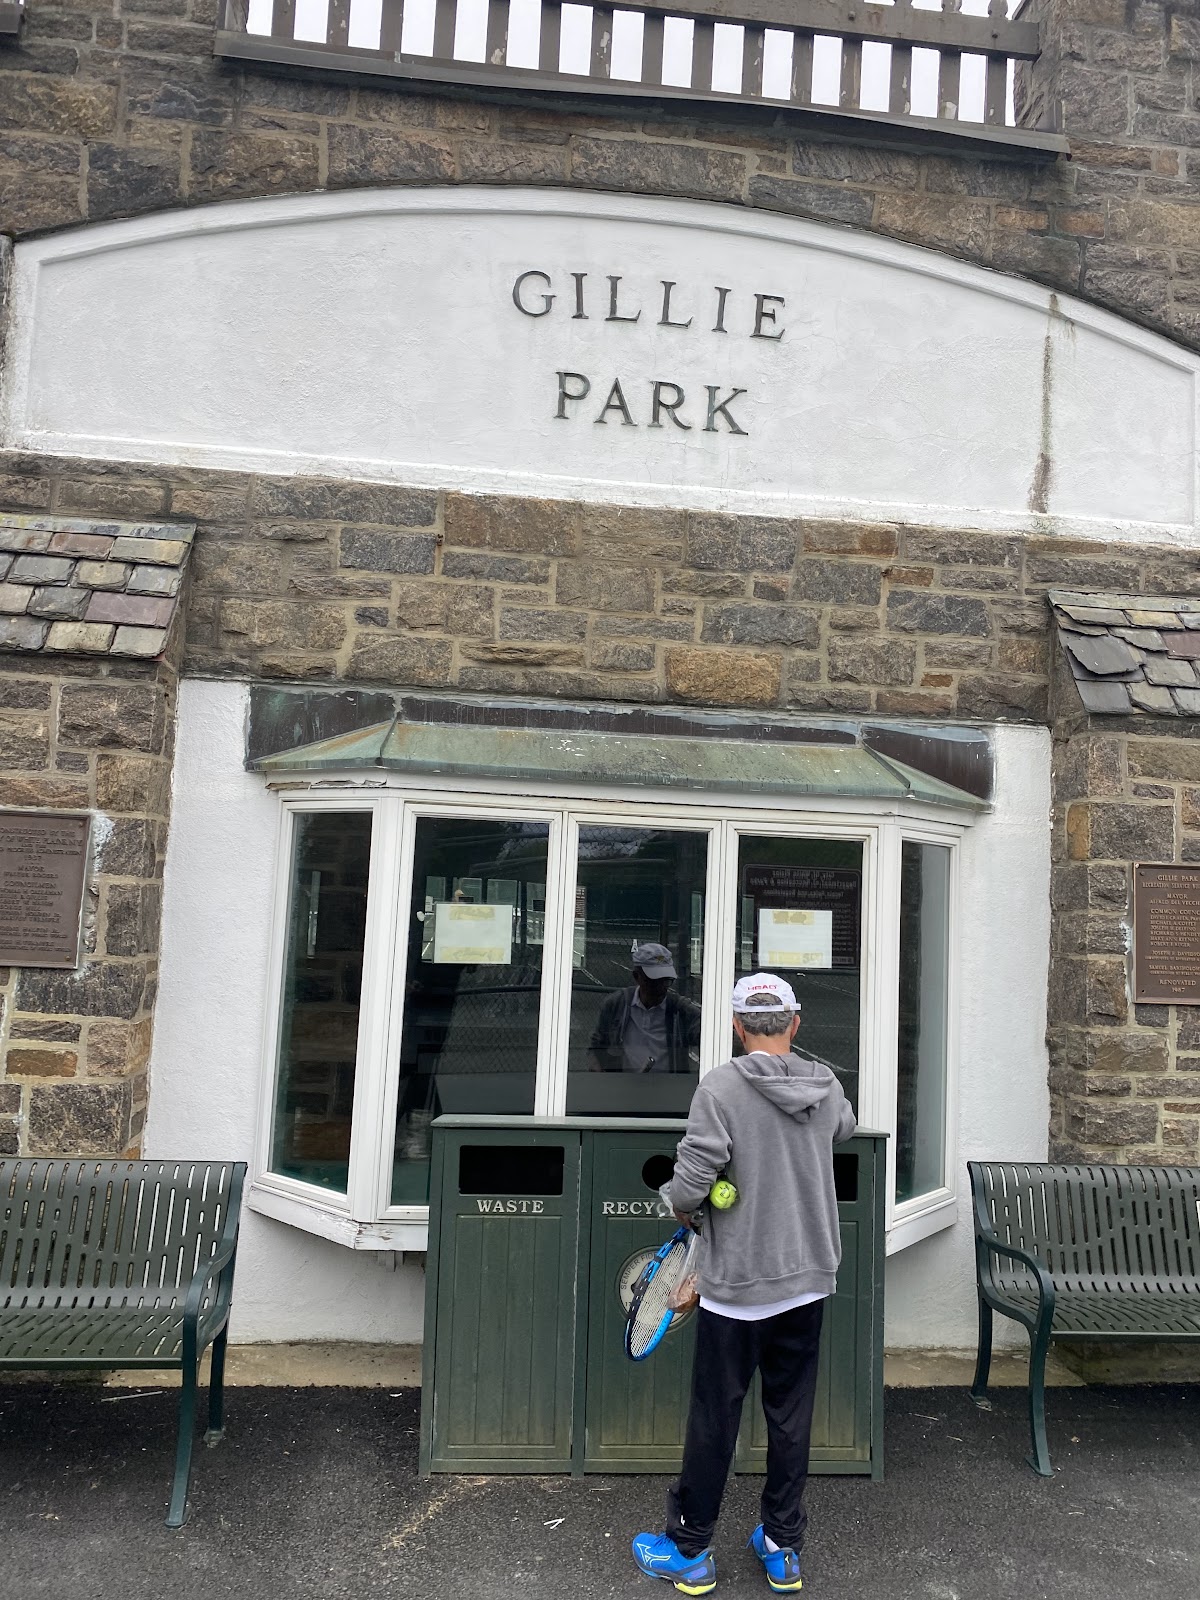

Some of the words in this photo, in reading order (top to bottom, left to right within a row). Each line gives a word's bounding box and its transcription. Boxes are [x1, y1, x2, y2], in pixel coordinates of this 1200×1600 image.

[512, 270, 786, 341] GILLIE
[553, 371, 749, 436] PARK
[476, 1199, 545, 1214] WASTE
[601, 1201, 672, 1216] RECYC
[620, 1259, 641, 1291] SEMPER
